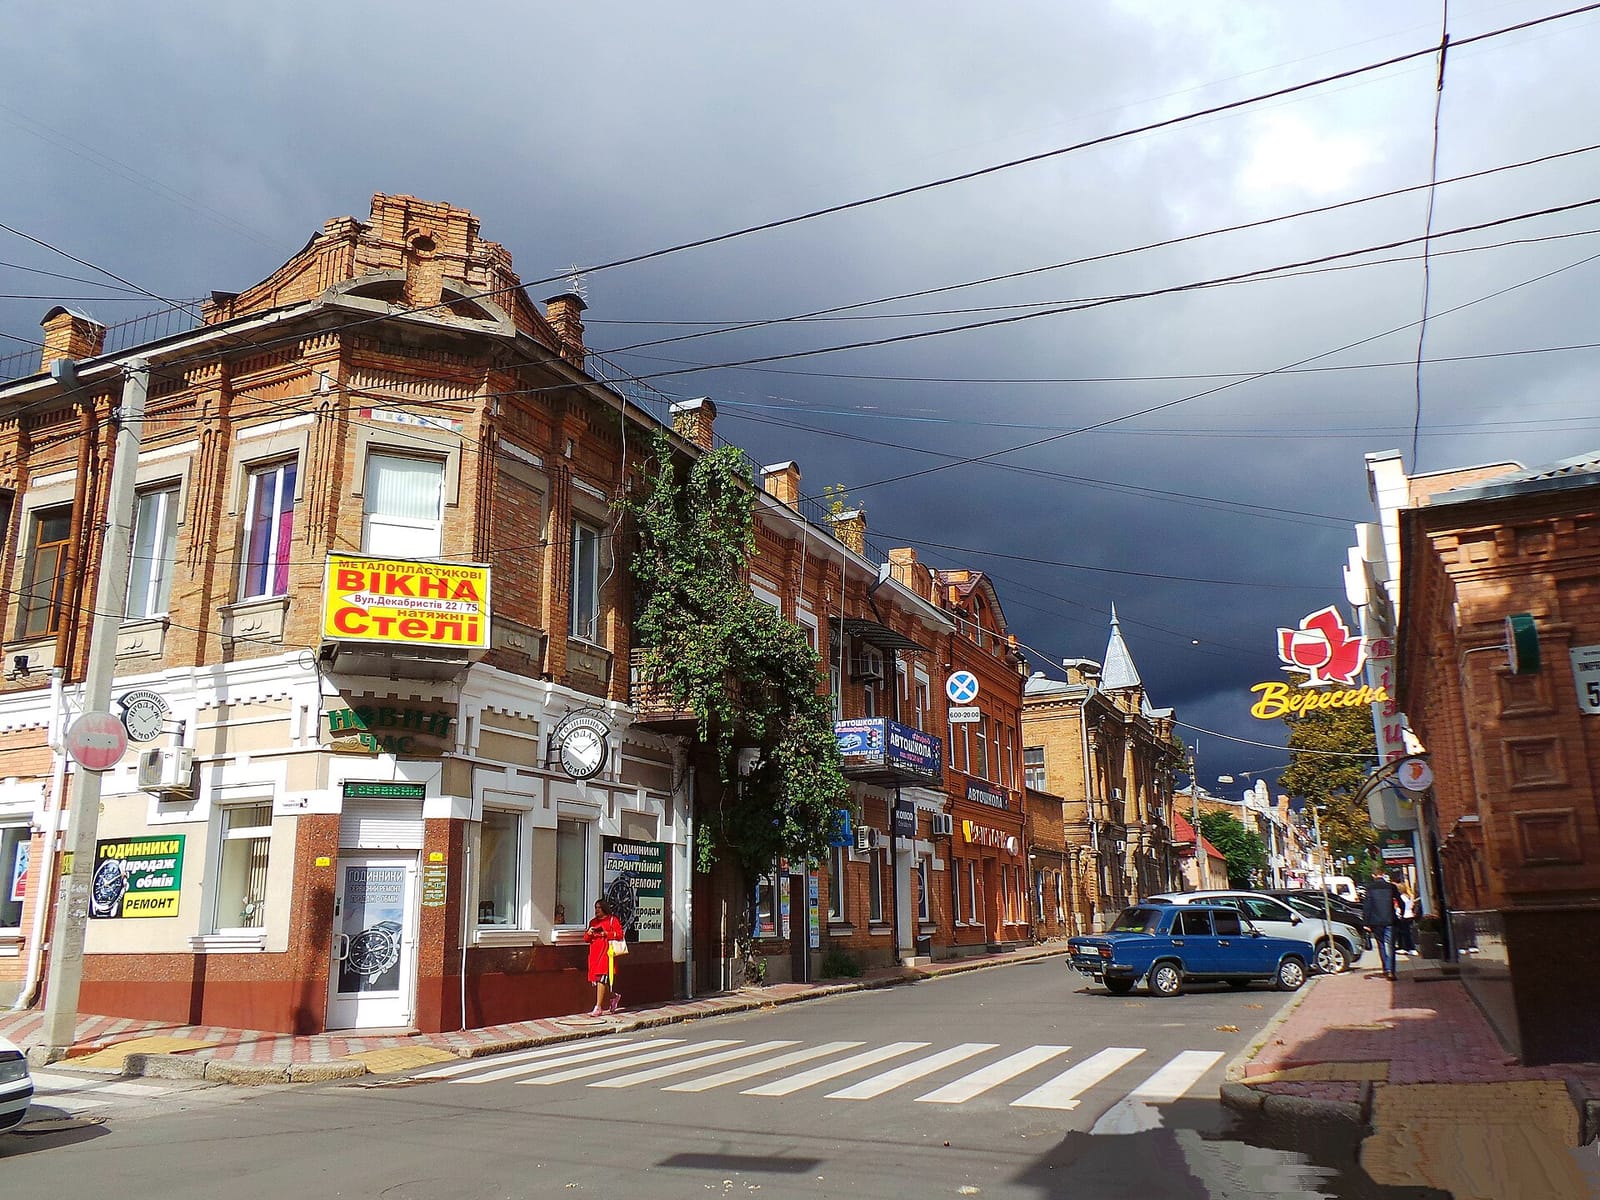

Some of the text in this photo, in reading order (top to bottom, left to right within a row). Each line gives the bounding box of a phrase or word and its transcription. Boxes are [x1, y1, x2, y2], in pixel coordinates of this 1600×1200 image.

[338, 559, 482, 580] МЕТАЛОПЛАСТИКОВІ
[337, 569, 480, 601] ВІКНА
[354, 594, 443, 609] Вул.Декабристів
[445, 601, 458, 610] 22
[466, 603, 478, 612] 75
[334, 607, 478, 642] Стелі
[397, 610, 465, 621] натяжні
[1250, 682, 1390, 720] Вересень
[128, 702, 161, 720] ПРОДАЖ
[128, 722, 160, 740] РЕМОНТ
[327, 704, 451, 740] НОВИЙ
[834, 719, 883, 728] АВТОШКОЛА
[359, 732, 415, 754] ЧАС
[563, 729, 599, 749] ПРОДАЖ
[890, 732, 932, 759] АВТОШКОЛА
[563, 758, 598, 776] РЕМОНТ
[967, 787, 1003, 809] АВТОШКОЛА
[100, 841, 180, 859] ГОДИННИКИ
[612, 843, 660, 857] ГОДИННИКИ
[126, 858, 177, 874] продаж
[607, 858, 663, 873] ГАРАНТІЙНИЙ
[136, 873, 174, 889] обмін
[349, 870, 403, 882] ГОДИННИКИ
[629, 878, 662, 889] РЕМОНТ
[125, 897, 175, 910] РЕМОНТ
[635, 906, 661, 917] продаж
[643, 919, 662, 930] обмін
